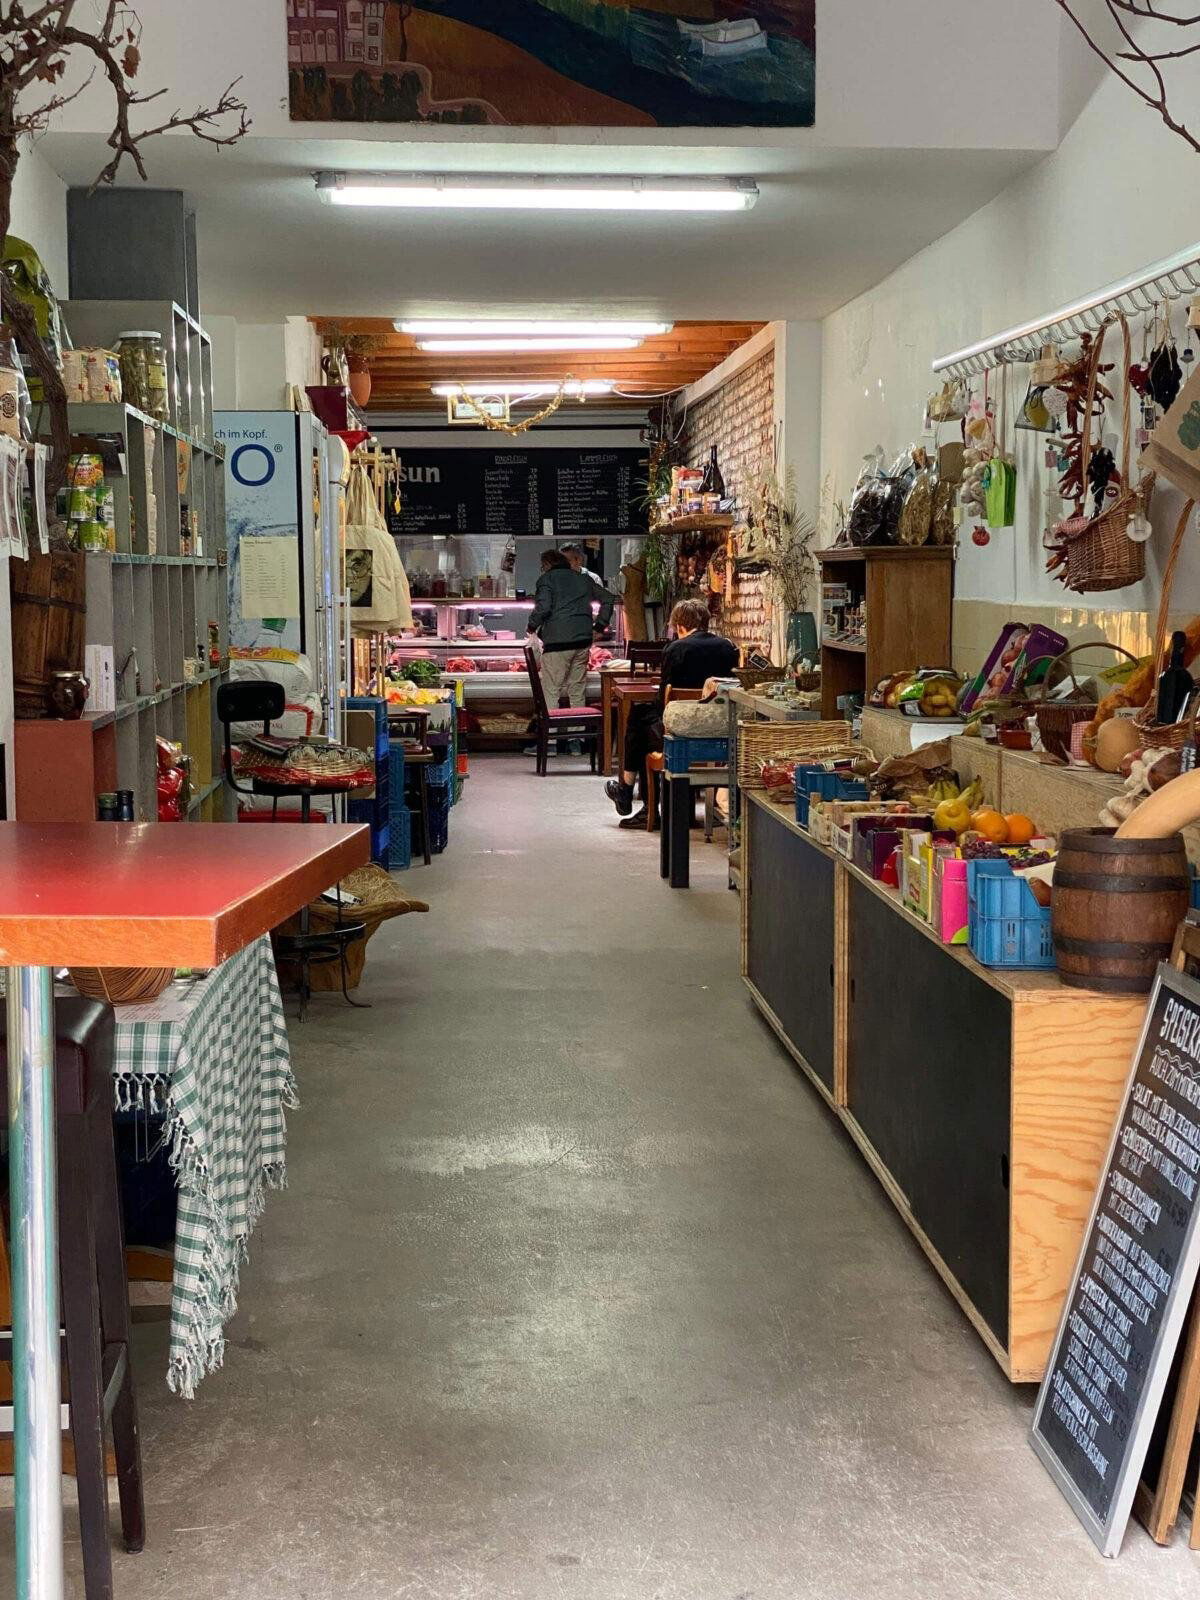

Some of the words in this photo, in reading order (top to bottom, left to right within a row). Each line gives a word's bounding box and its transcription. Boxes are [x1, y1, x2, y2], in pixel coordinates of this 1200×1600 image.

[228, 429, 241, 439] im
[242, 429, 268, 440] Kopf.
[386, 466, 441, 483] sun
[1149, 1053, 1168, 1082] AUCH
[1132, 1080, 1152, 1110] SALAT
